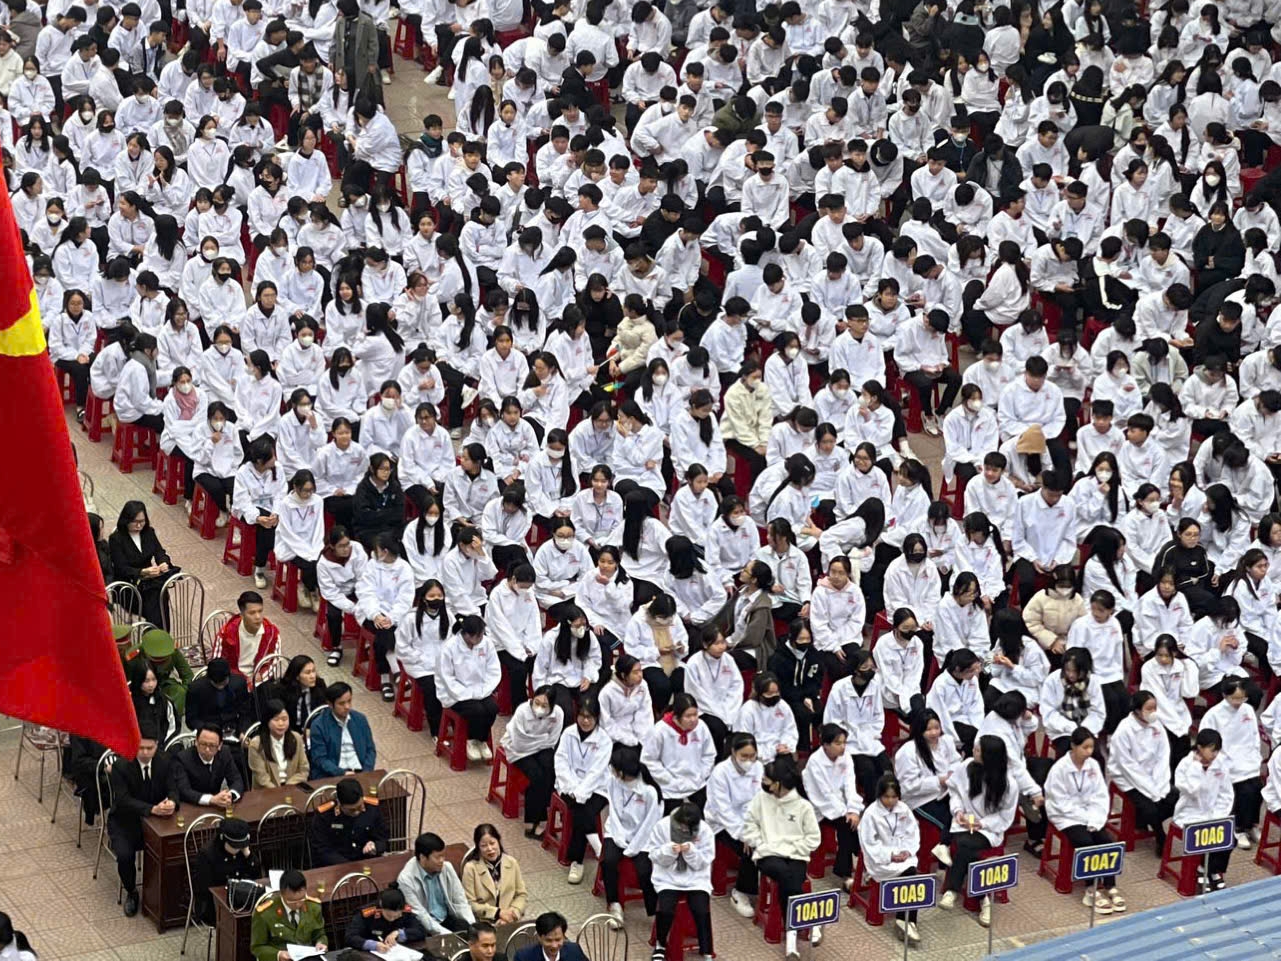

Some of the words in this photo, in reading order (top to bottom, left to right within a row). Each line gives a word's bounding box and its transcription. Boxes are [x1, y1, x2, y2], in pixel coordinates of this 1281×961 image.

[1194, 825, 1225, 847] 10A6
[1083, 851, 1119, 872] 10A7
[979, 864, 1009, 887] 10A8
[892, 884, 926, 904] 10A9
[795, 898, 833, 922] 10A10
